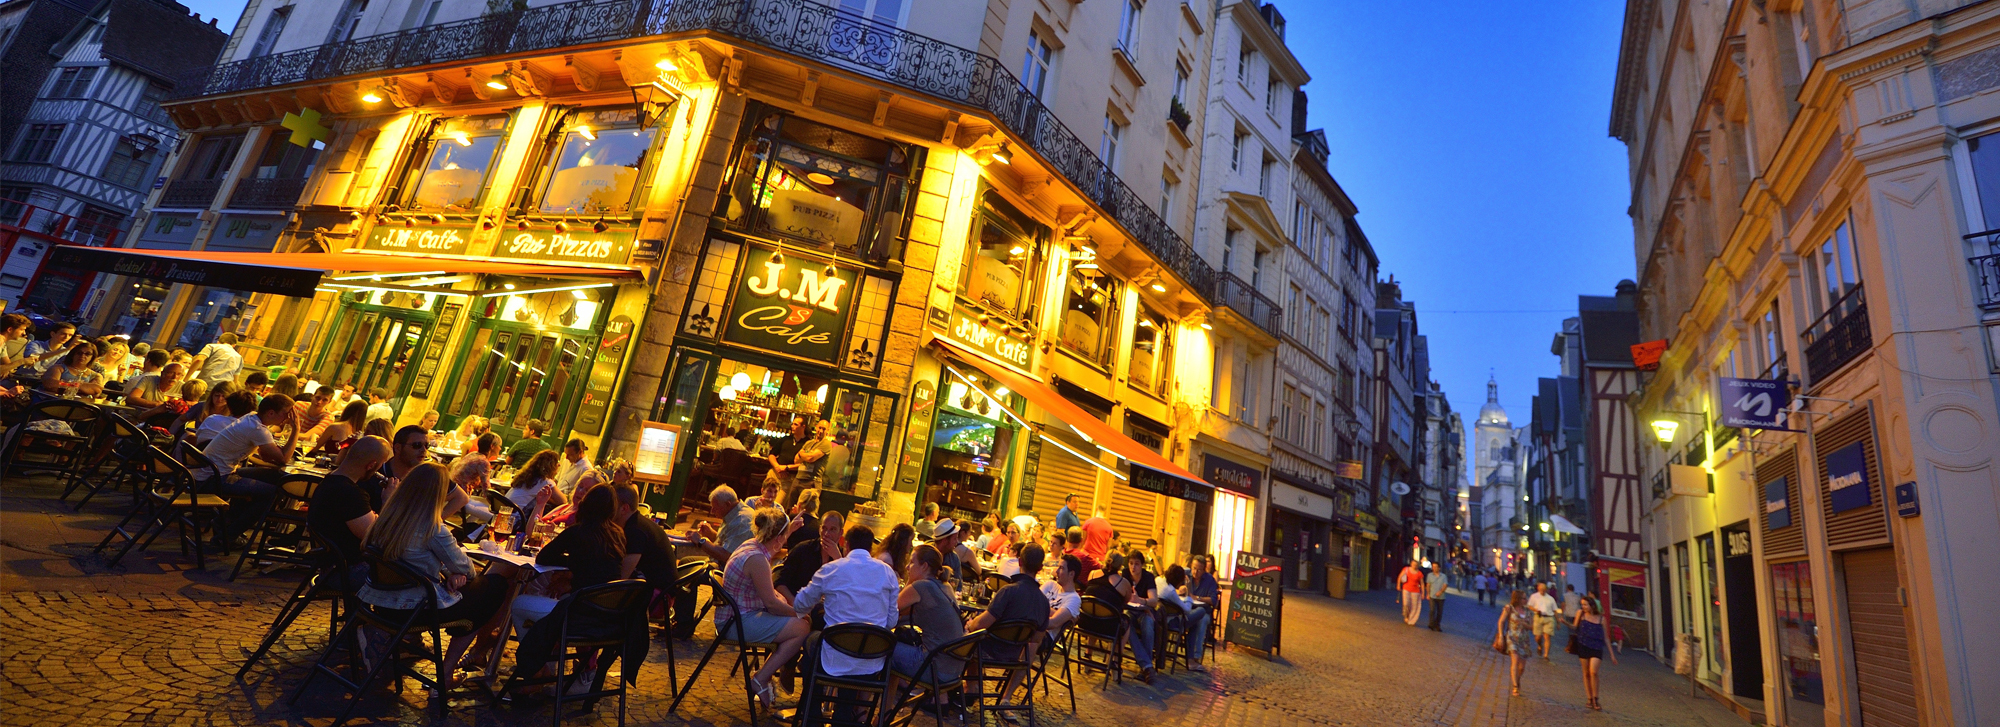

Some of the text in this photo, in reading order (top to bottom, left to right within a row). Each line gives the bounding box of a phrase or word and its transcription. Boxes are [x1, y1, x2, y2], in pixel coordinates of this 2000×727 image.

[418, 229, 458, 250] Café
[509, 233, 613, 258] Pub Pizzas
[165, 262, 206, 282] Brasserie
[738, 306, 832, 344] Café
[598, 352, 618, 364] GRILL
[994, 336, 1028, 366] Café
[1728, 416, 1784, 428] MICROMAN
[1184, 484, 1208, 502] Brasserie
[1236, 580, 1272, 596] GRILL
[1236, 590, 1270, 606] PIZZAS
[1234, 600, 1272, 618] SALADES
[1232, 610, 1268, 628] PATES
